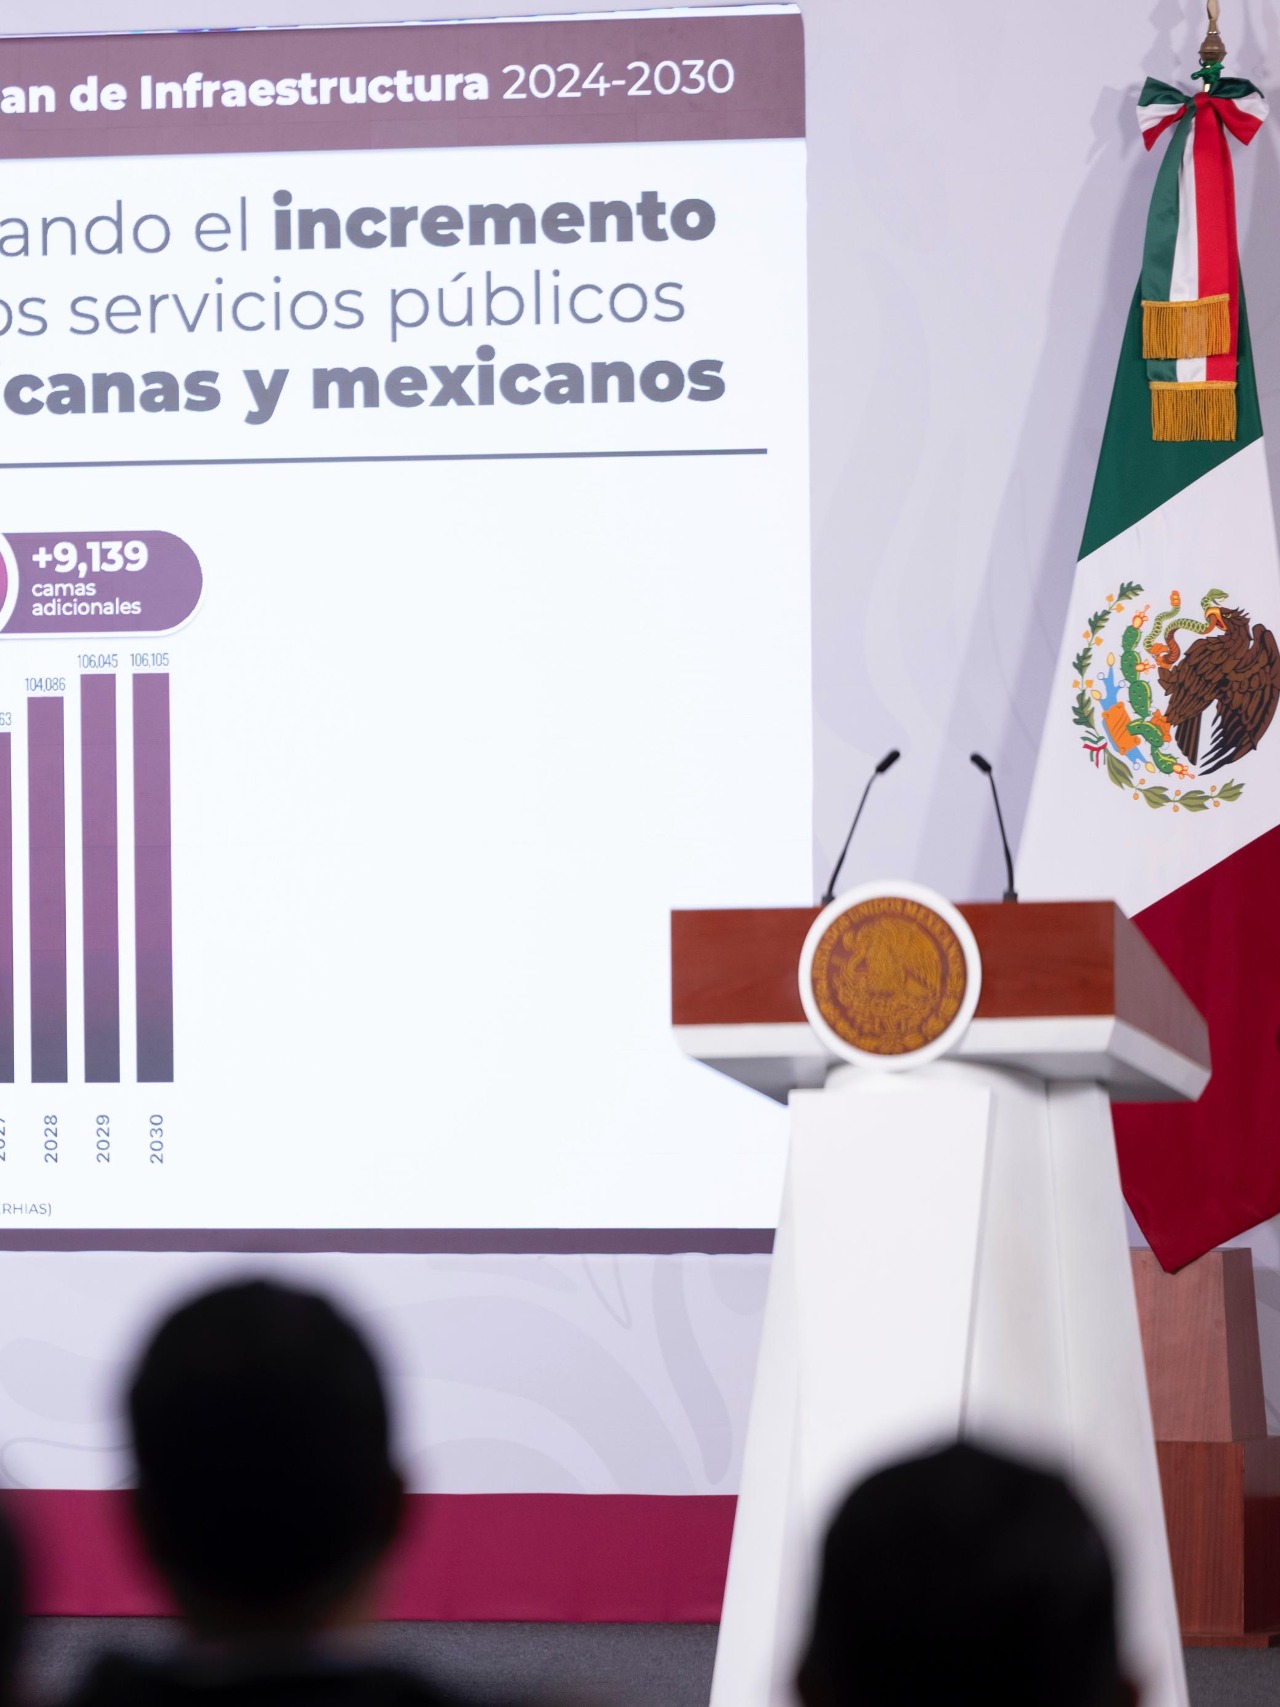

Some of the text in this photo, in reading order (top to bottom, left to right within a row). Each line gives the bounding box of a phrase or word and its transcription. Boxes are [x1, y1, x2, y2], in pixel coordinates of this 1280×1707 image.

[70, 75, 127, 111] de
[141, 70, 489, 109] Infraestructura
[502, 59, 734, 99] 2024-2030
[195, 196, 246, 252] el
[273, 190, 716, 250] incremento
[70, 276, 364, 335] servicios
[391, 269, 684, 342] públicos
[243, 369, 289, 425] y
[313, 345, 725, 409] mexicanos
[32, 540, 148, 578] +9,139
[32, 583, 96, 597] camas
[32, 597, 141, 616] adicionales
[78, 654, 118, 668] 106,045
[130, 653, 169, 666] 106,105
[25, 677, 65, 691] 104,086
[44, 1115, 58, 1163] 2028
[96, 1115, 110, 1163] 2029
[150, 1115, 163, 1163] 2030
